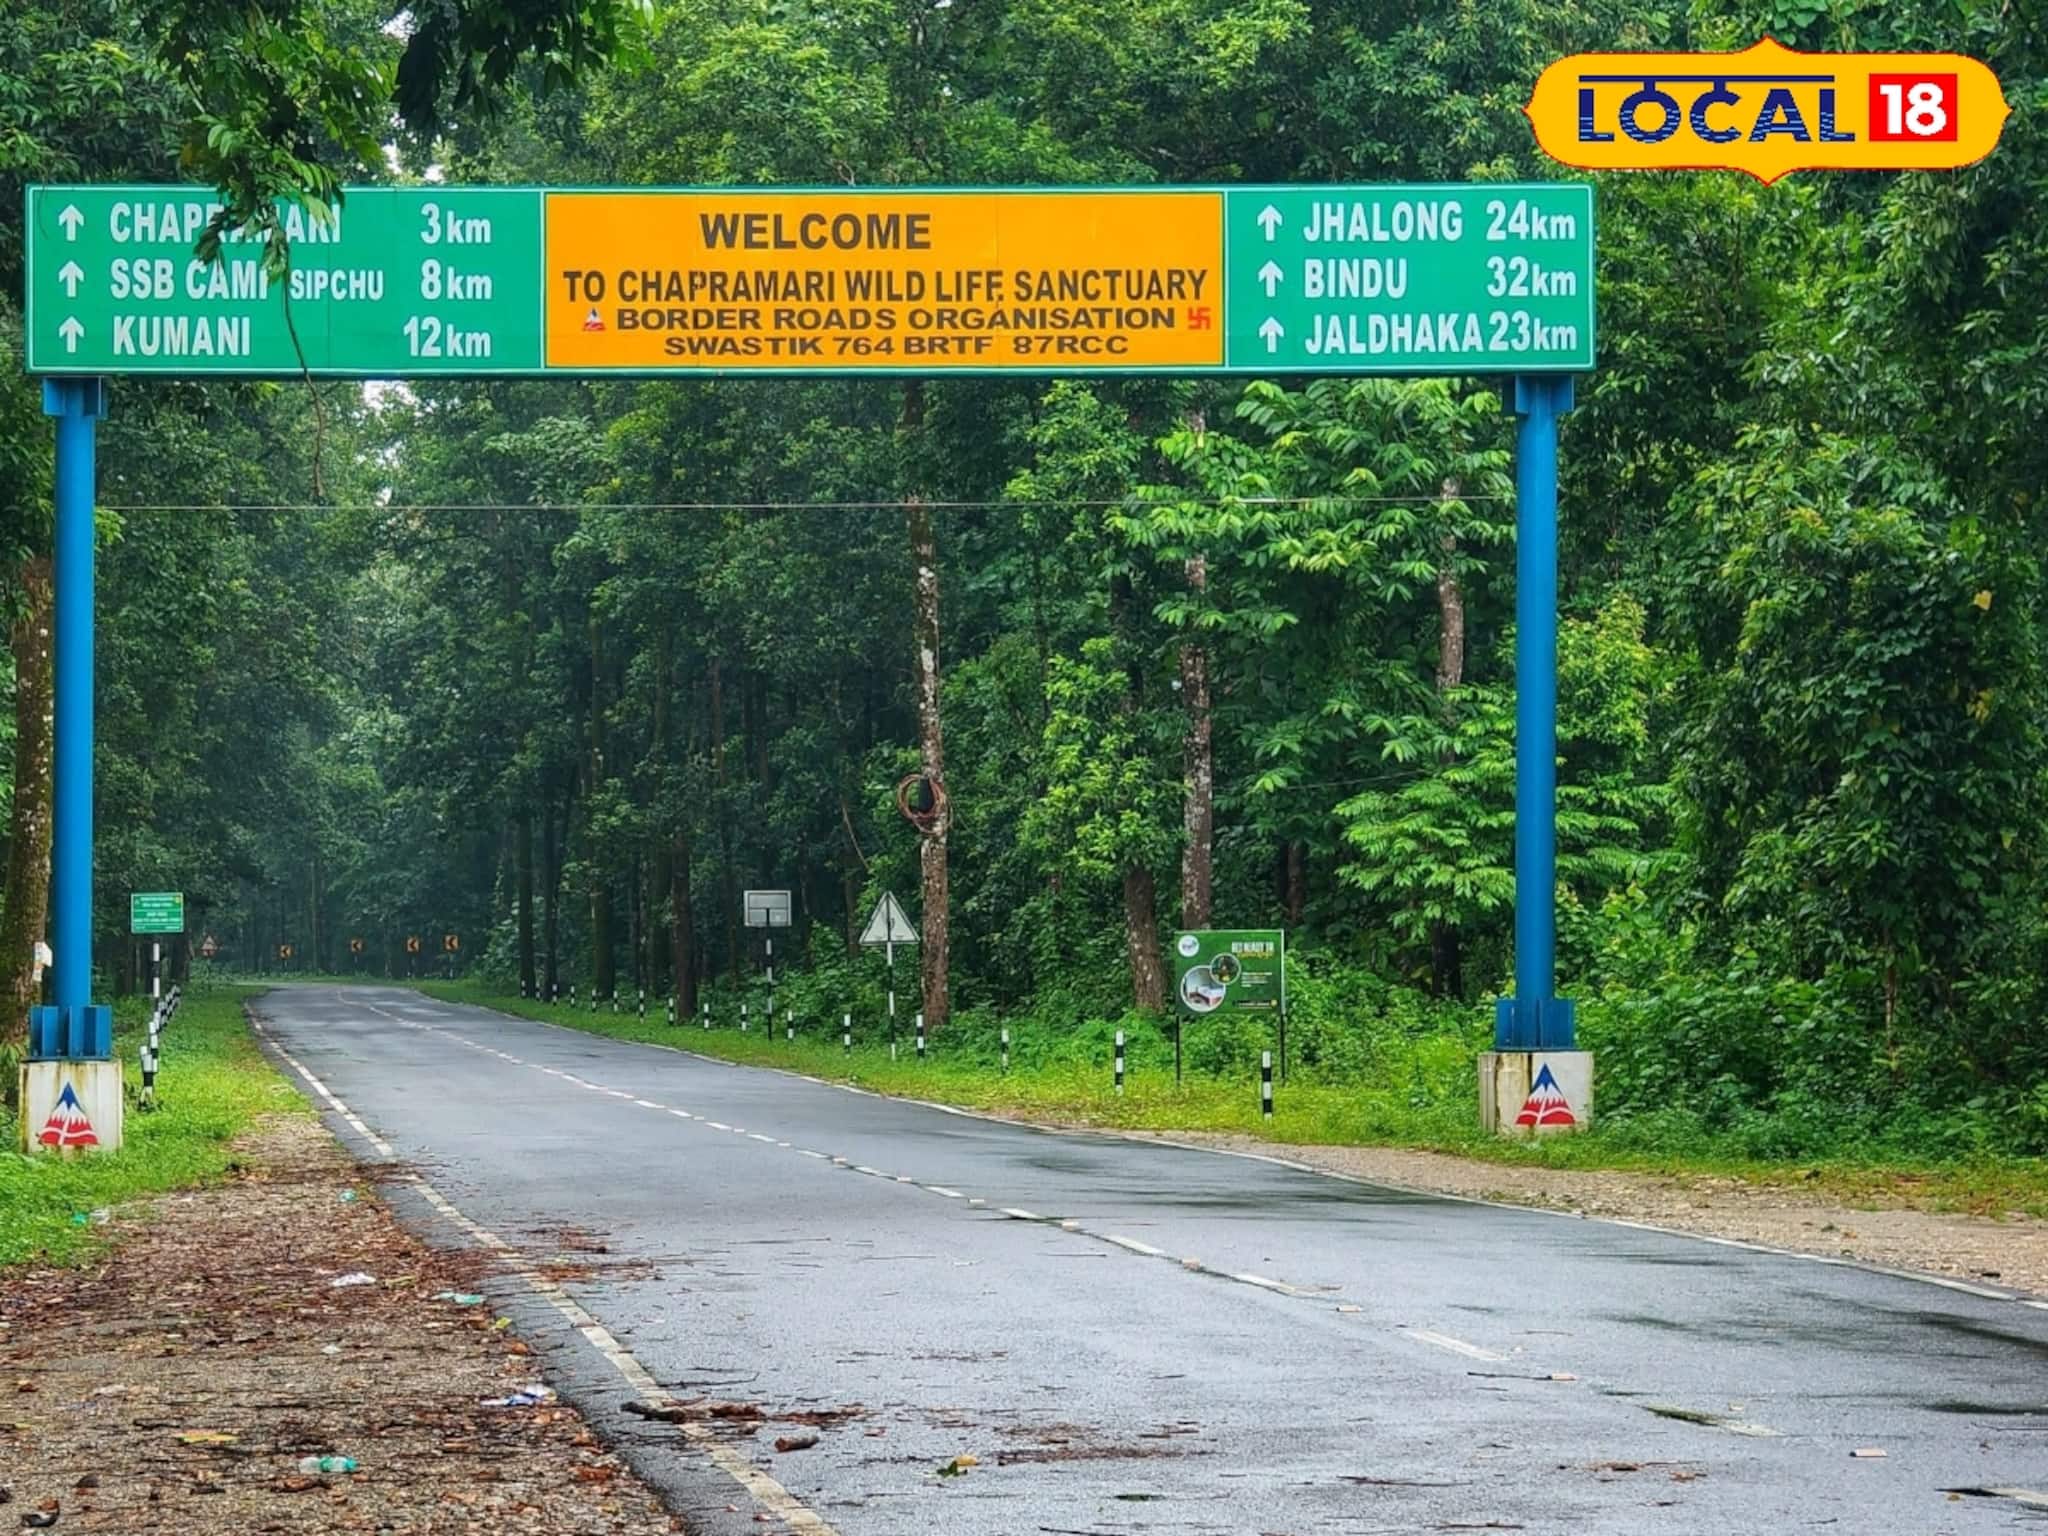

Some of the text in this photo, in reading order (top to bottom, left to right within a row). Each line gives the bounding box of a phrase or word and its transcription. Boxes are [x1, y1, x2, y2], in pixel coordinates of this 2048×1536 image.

[701, 214, 931, 250] WELCOME
[1303, 200, 1575, 242] JHALONG 24km
[110, 258, 174, 299] SSB
[290, 269, 384, 299] SIPCHU
[563, 269, 1207, 302] TO CHAPRAMARI WILD LIFE SANCTUARY
[1304, 256, 1576, 299] BINDU 32km
[113, 316, 250, 356] KUMANI
[617, 307, 1175, 331] BORDER ROADS ORGANISATION
[1305, 310, 1577, 354] JALDHAKA 23km
[664, 335, 1128, 356] SWASTIK 764 BRTF 87RCC
